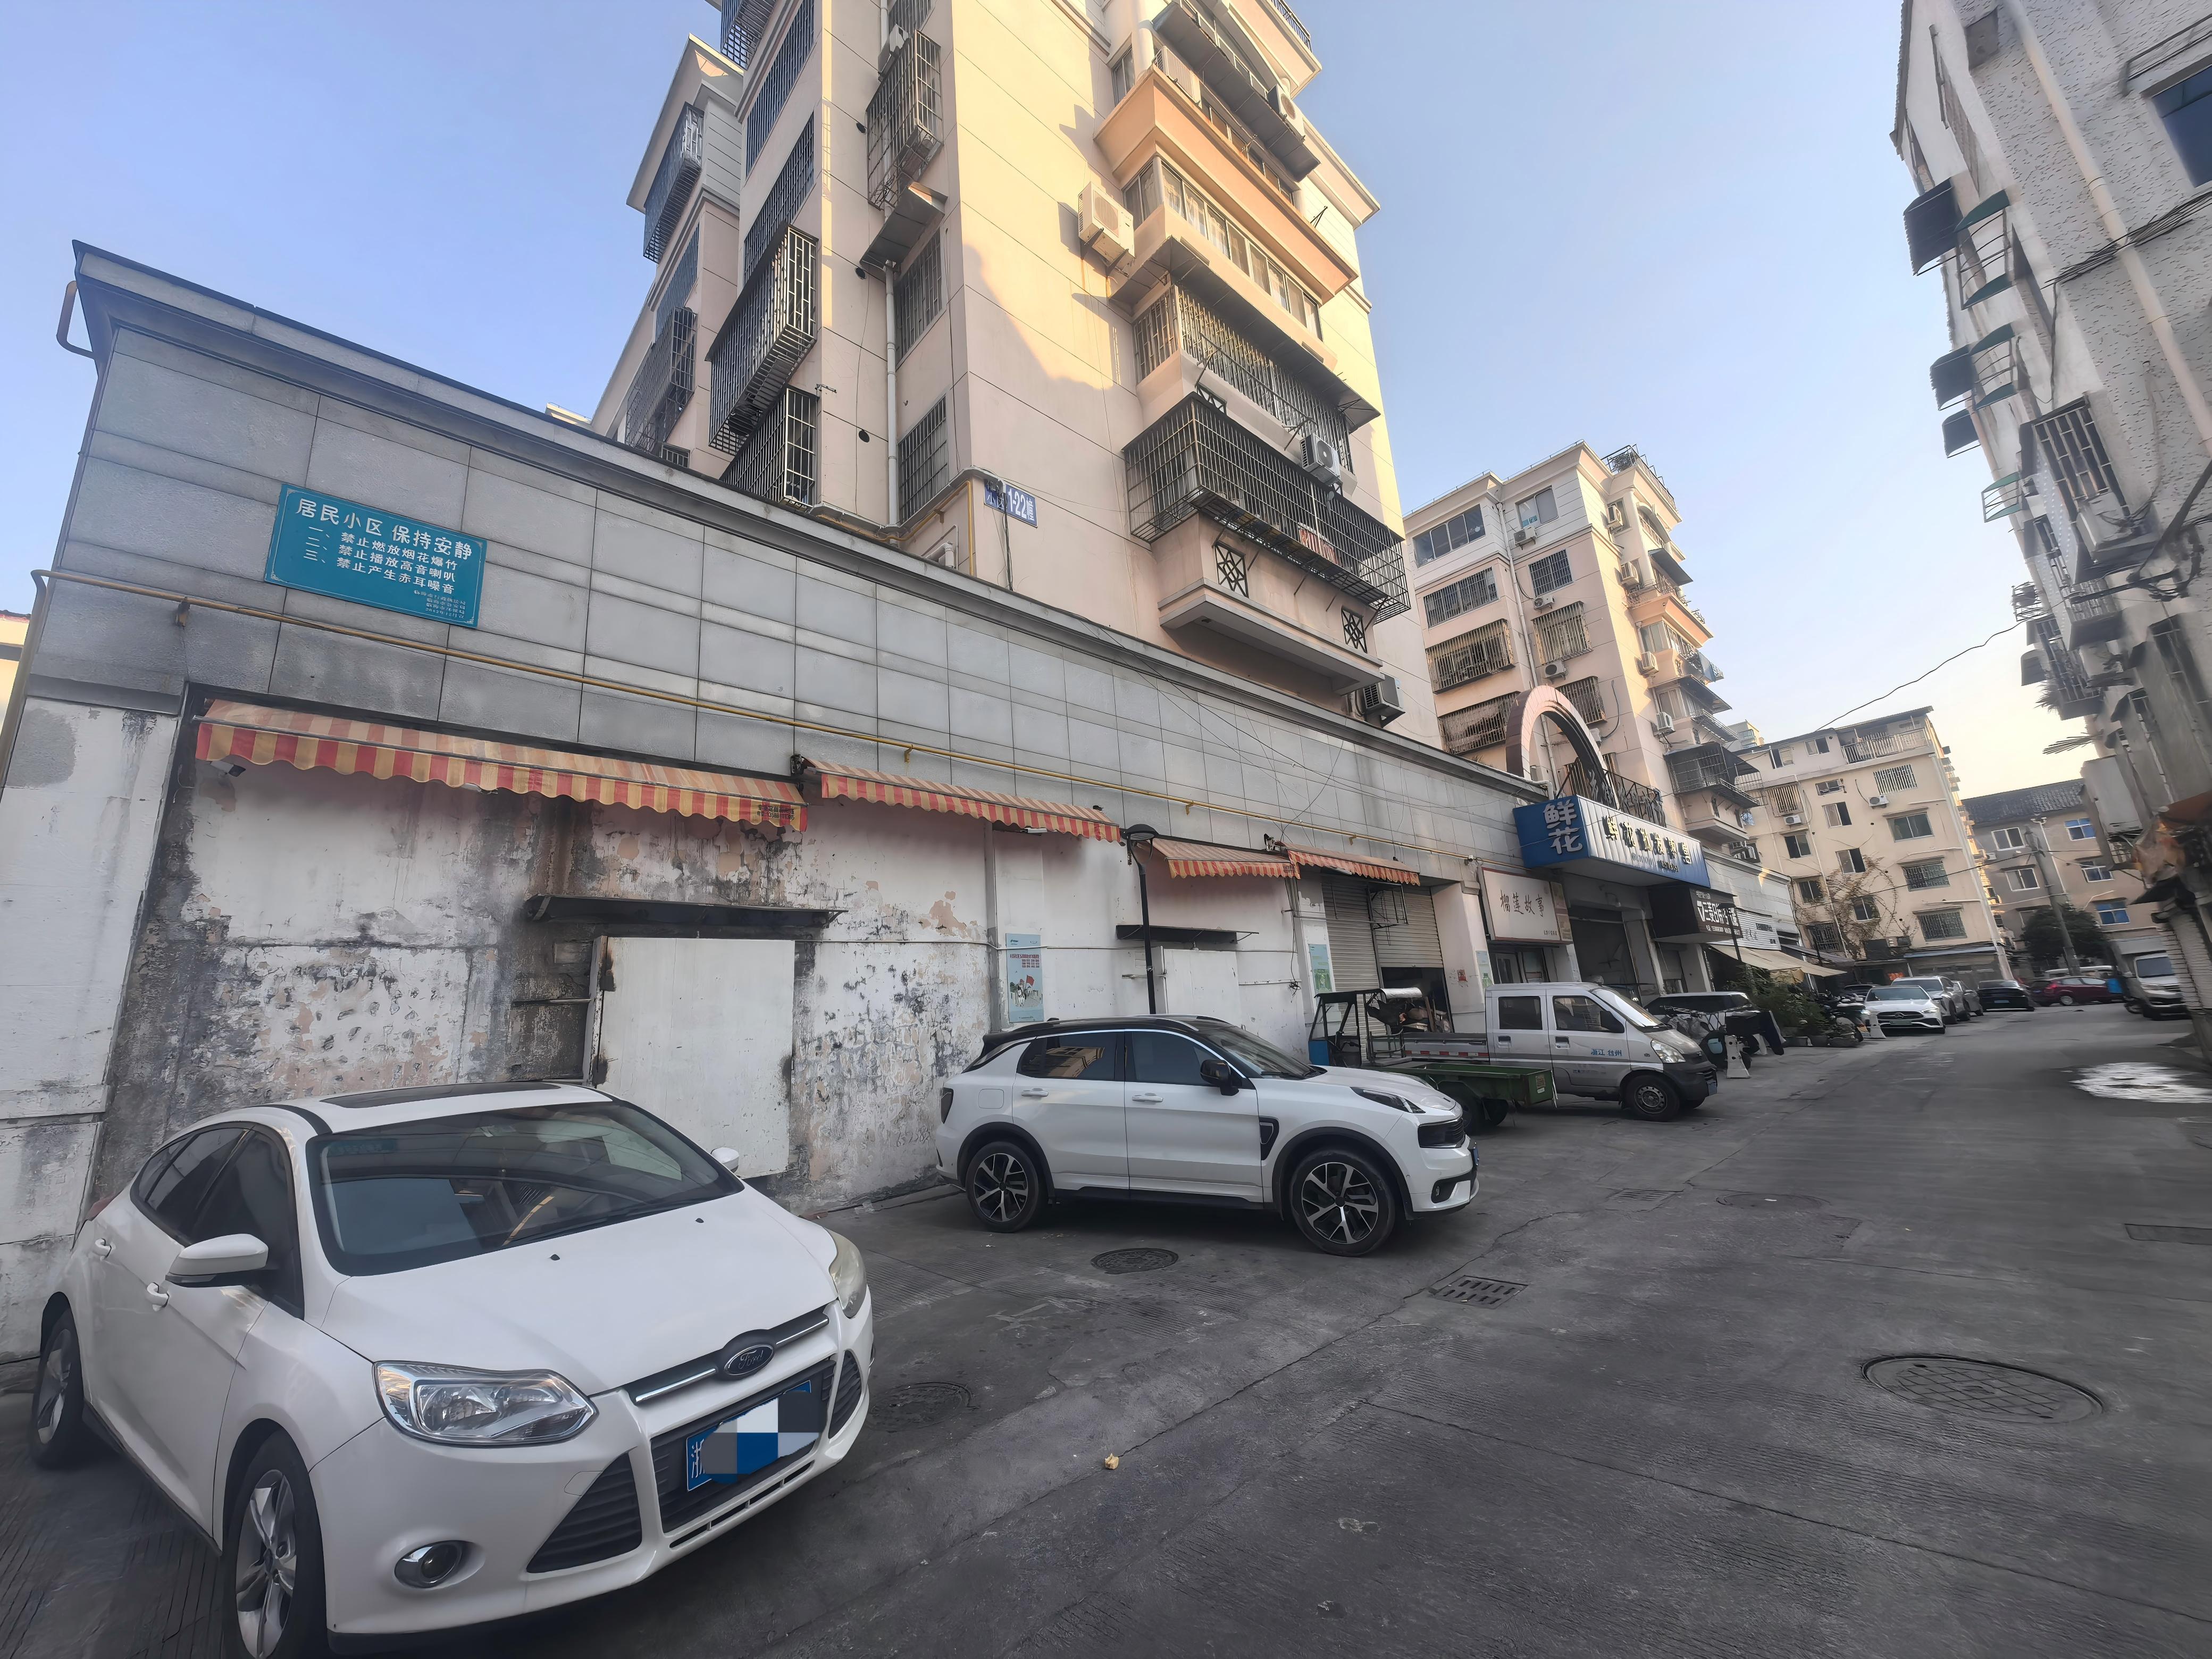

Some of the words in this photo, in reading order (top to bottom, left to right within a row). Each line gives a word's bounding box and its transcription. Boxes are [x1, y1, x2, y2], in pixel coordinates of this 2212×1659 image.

[295, 498, 383, 536] 居民小区
[391, 524, 472, 560] 保持安静
[1543, 799, 1583, 854] 鲜花
[1499, 889, 1545, 918] 榴莲故事
[738, 1350, 764, 1370] Ford
